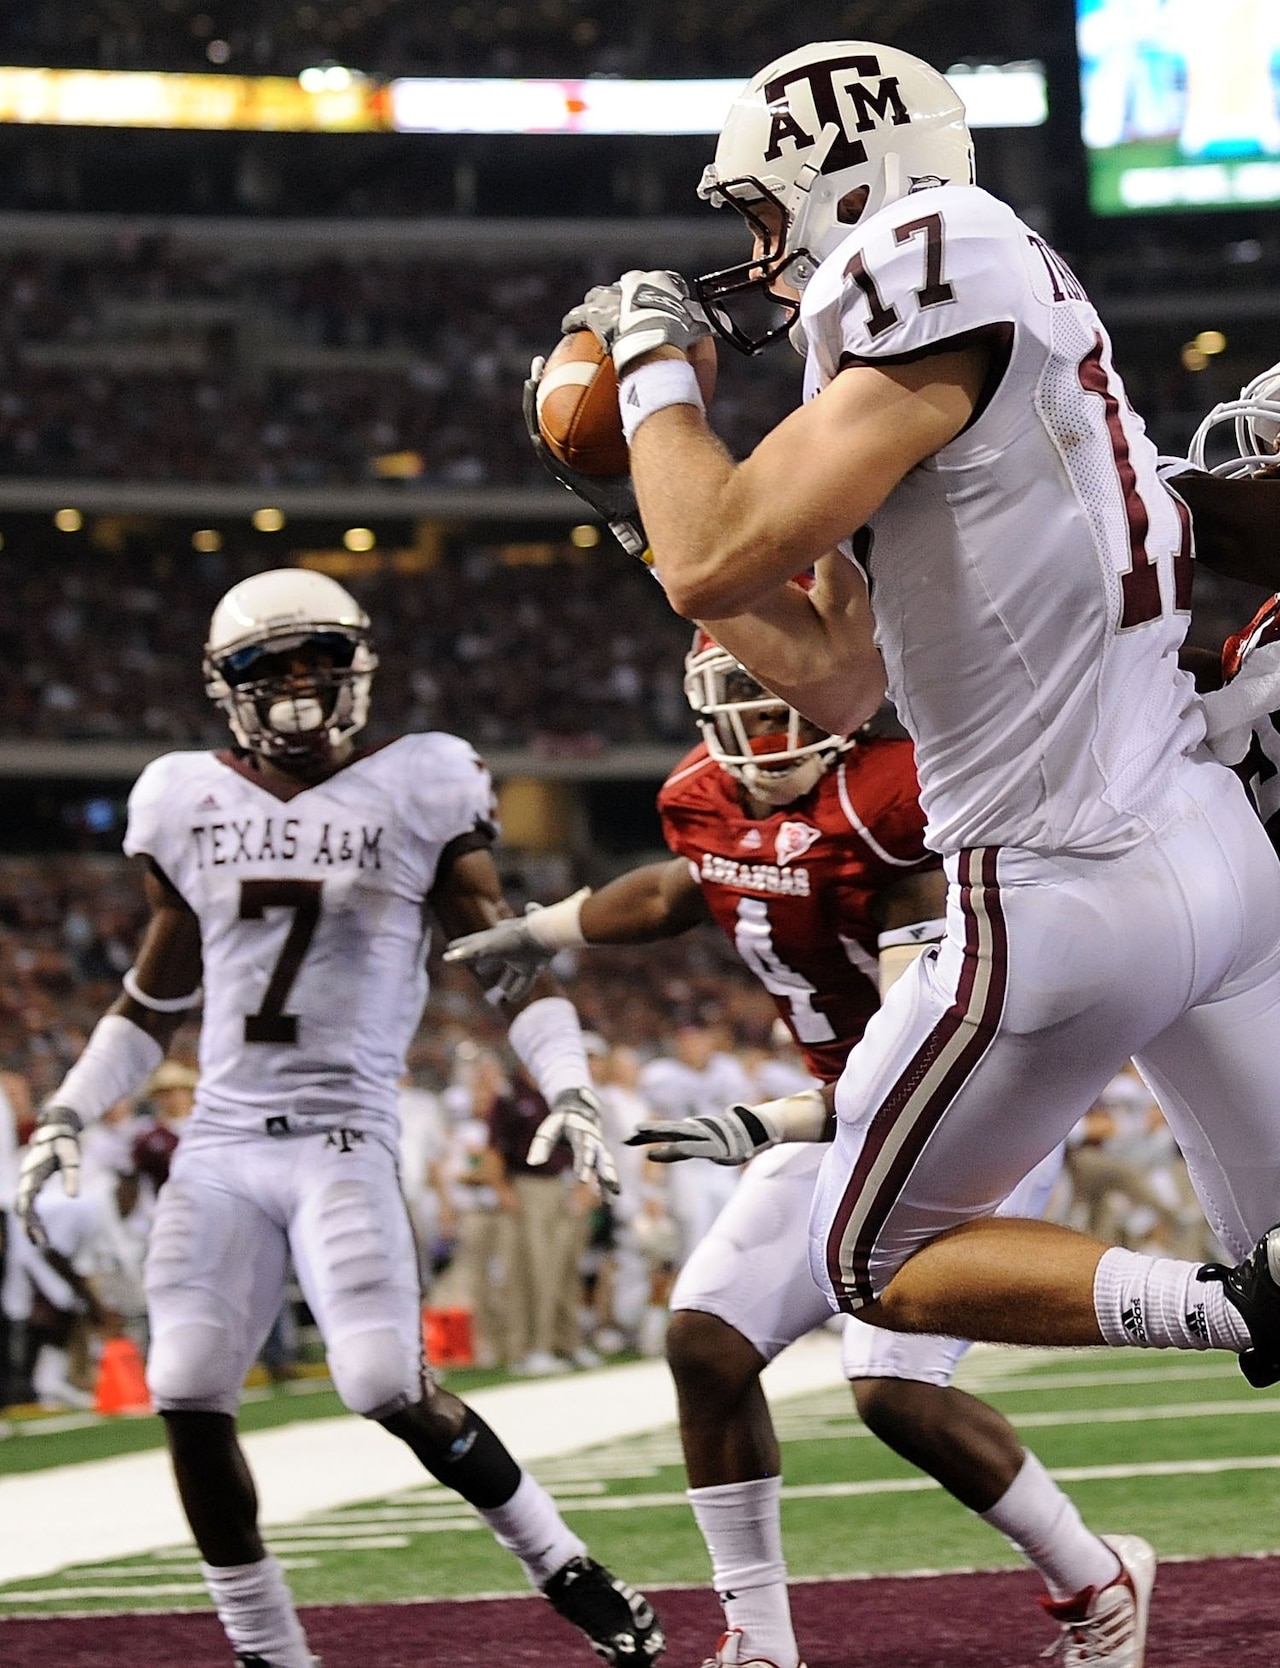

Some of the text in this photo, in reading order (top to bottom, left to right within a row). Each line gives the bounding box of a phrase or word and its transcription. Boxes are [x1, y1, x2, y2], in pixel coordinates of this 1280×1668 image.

[841, 211, 958, 342] 17
[191, 818, 384, 870] TEXAS A&M
[238, 878, 324, 1044] 7
[734, 896, 838, 1044] 4
